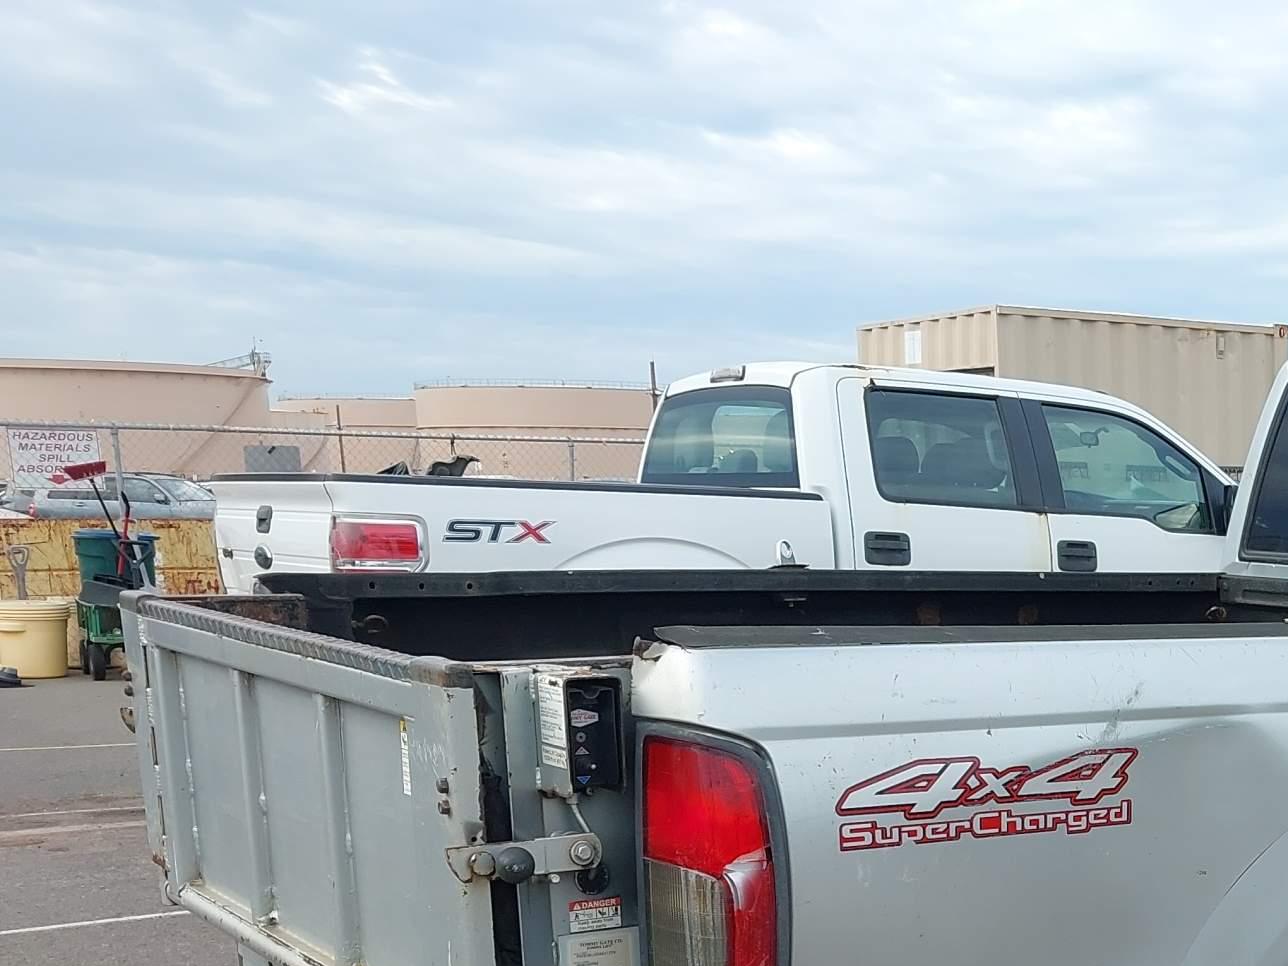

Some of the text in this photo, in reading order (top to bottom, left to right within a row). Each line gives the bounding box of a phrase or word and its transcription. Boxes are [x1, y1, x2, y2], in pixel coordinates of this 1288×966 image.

[12, 431, 94, 442] HAZARDOUS
[17, 443, 91, 453] MATERIALS
[39, 453, 74, 463] SPILL
[441, 518, 558, 544] STX
[835, 748, 1138, 820] 4x4
[839, 799, 1132, 852] SuperCharged
[581, 898, 617, 909] DANGER
